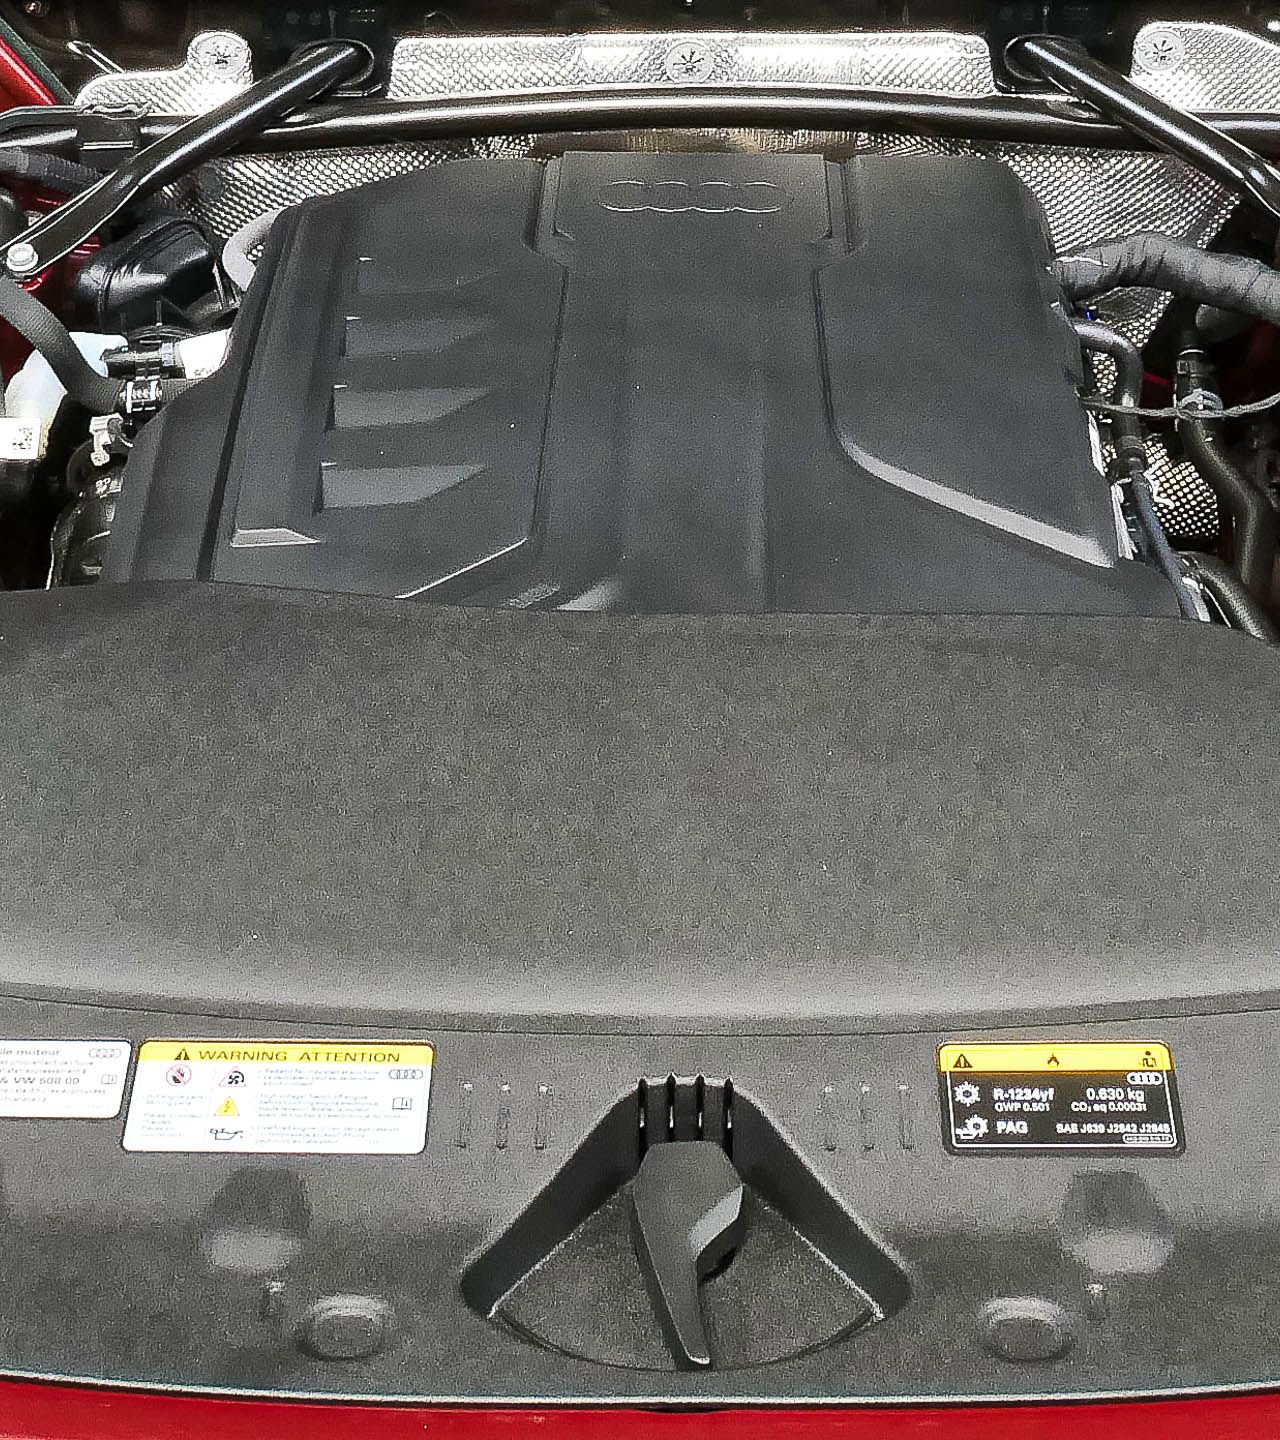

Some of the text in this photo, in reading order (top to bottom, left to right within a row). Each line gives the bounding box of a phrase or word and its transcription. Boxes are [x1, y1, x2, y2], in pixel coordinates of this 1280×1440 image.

[16, 1048, 60, 1056] moteur
[198, 1050, 400, 1063] WARNING ATTENTION
[13, 1076, 36, 1085] VW
[993, 1087, 1055, 1102] R-1234yf
[1086, 1087, 1145, 1103] 0.630 kg
[994, 1102, 1050, 1113] GWP 0.501
[1093, 1103, 1108, 1114] eq
[996, 1120, 1029, 1135] PAG
[1055, 1123, 1080, 1135] SAE
[1107, 1123, 1139, 1135] J2842
